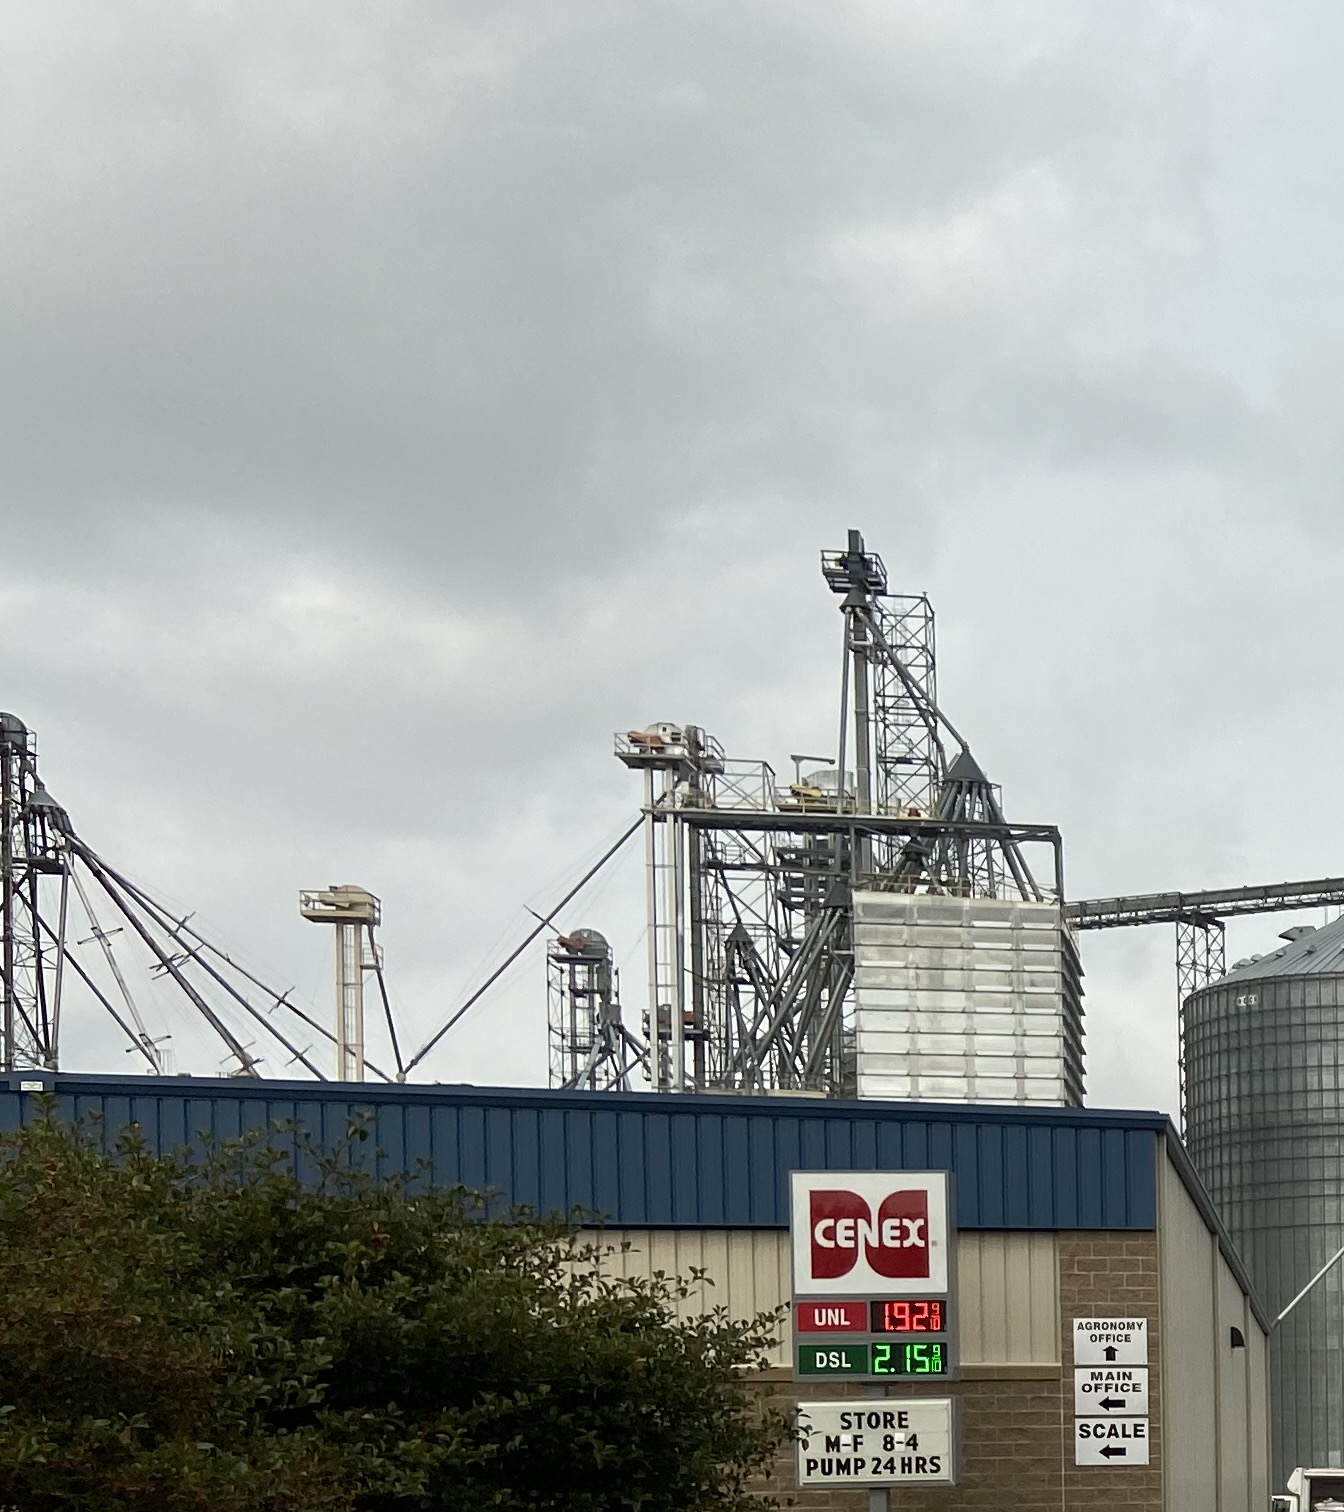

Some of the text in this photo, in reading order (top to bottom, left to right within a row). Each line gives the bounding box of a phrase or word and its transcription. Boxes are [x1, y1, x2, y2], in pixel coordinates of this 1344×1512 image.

[814, 1218, 926, 1249] CENEX
[814, 1308, 851, 1326] UNL
[885, 1302, 929, 1331] 1.92
[1077, 1321, 1144, 1331] AGRONOMY
[1089, 1333, 1132, 1343] OFFICE
[816, 1352, 851, 1368] DSL
[874, 1344, 929, 1373] 2.15
[1090, 1371, 1133, 1381] MAIN
[1081, 1383, 1142, 1393] OFFICE
[840, 1411, 909, 1430] STORE
[1079, 1424, 1146, 1439] SCALE
[825, 1433, 919, 1453] M-F 8-4
[806, 1456, 941, 1476] PUMP 24 HRS
